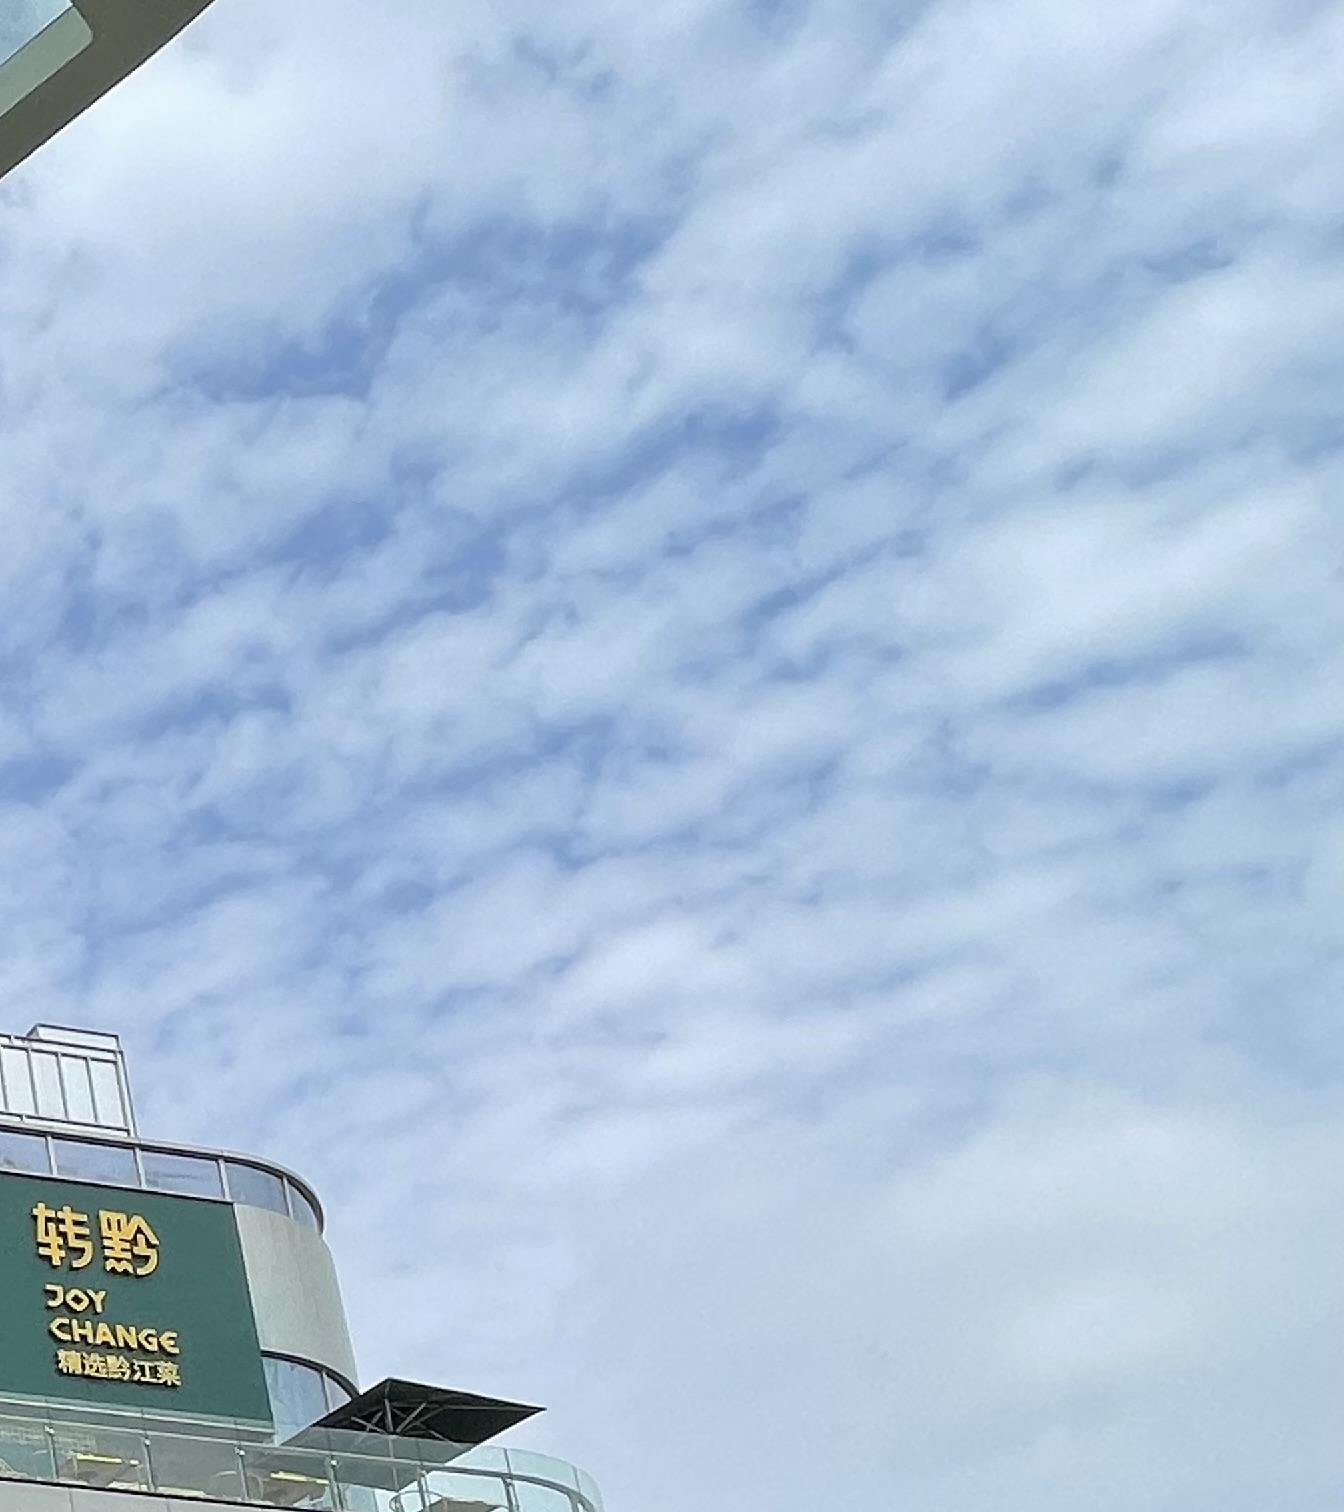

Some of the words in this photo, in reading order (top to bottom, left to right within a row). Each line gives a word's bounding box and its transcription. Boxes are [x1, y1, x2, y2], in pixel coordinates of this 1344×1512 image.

[32, 1202, 160, 1276] 转黔
[45, 1283, 106, 1313] JOY
[48, 1317, 181, 1354] CHANGE
[57, 1348, 182, 1387] 精选黔江菜
